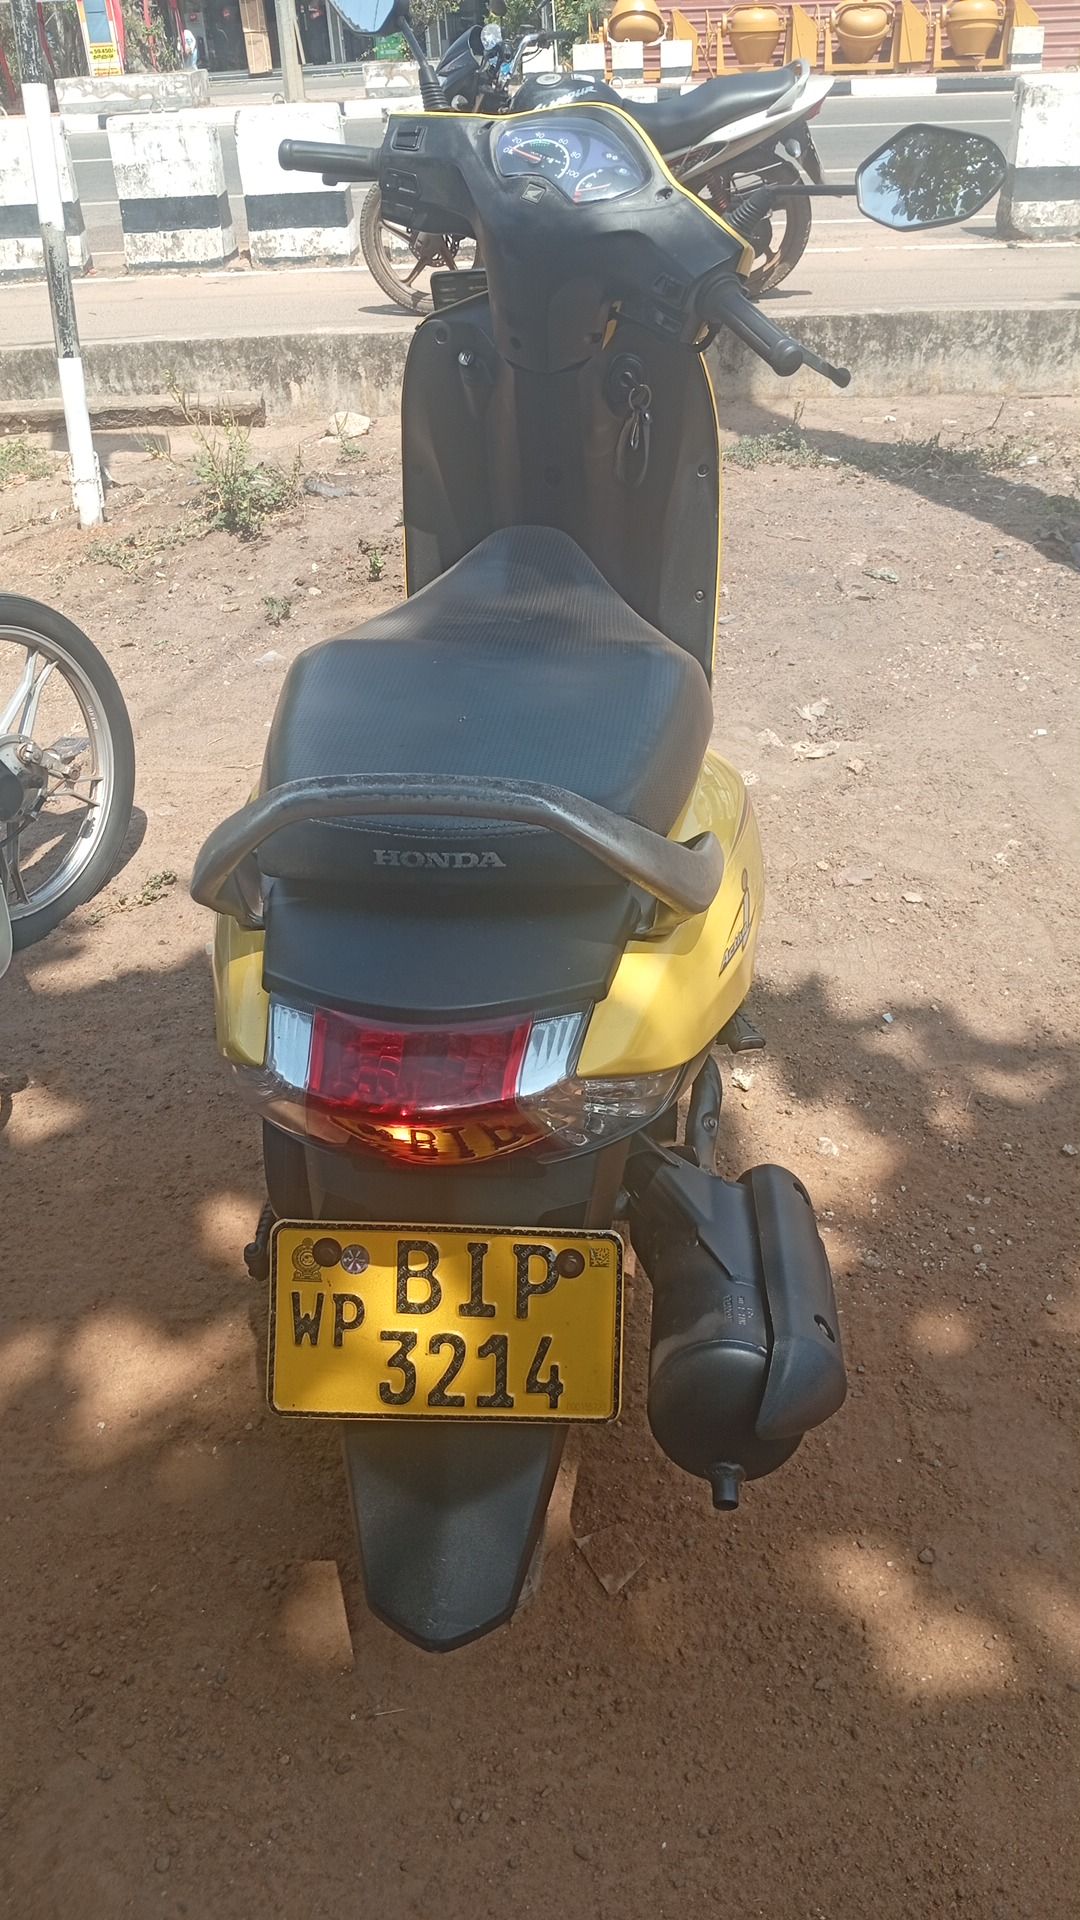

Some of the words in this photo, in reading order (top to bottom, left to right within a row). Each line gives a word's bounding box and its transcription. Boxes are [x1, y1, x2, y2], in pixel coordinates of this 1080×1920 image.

[372, 849, 507, 868] HONDA
[396, 1239, 561, 1321] BIP
[291, 1290, 366, 1348] WP
[378, 1330, 565, 1409] 3214
